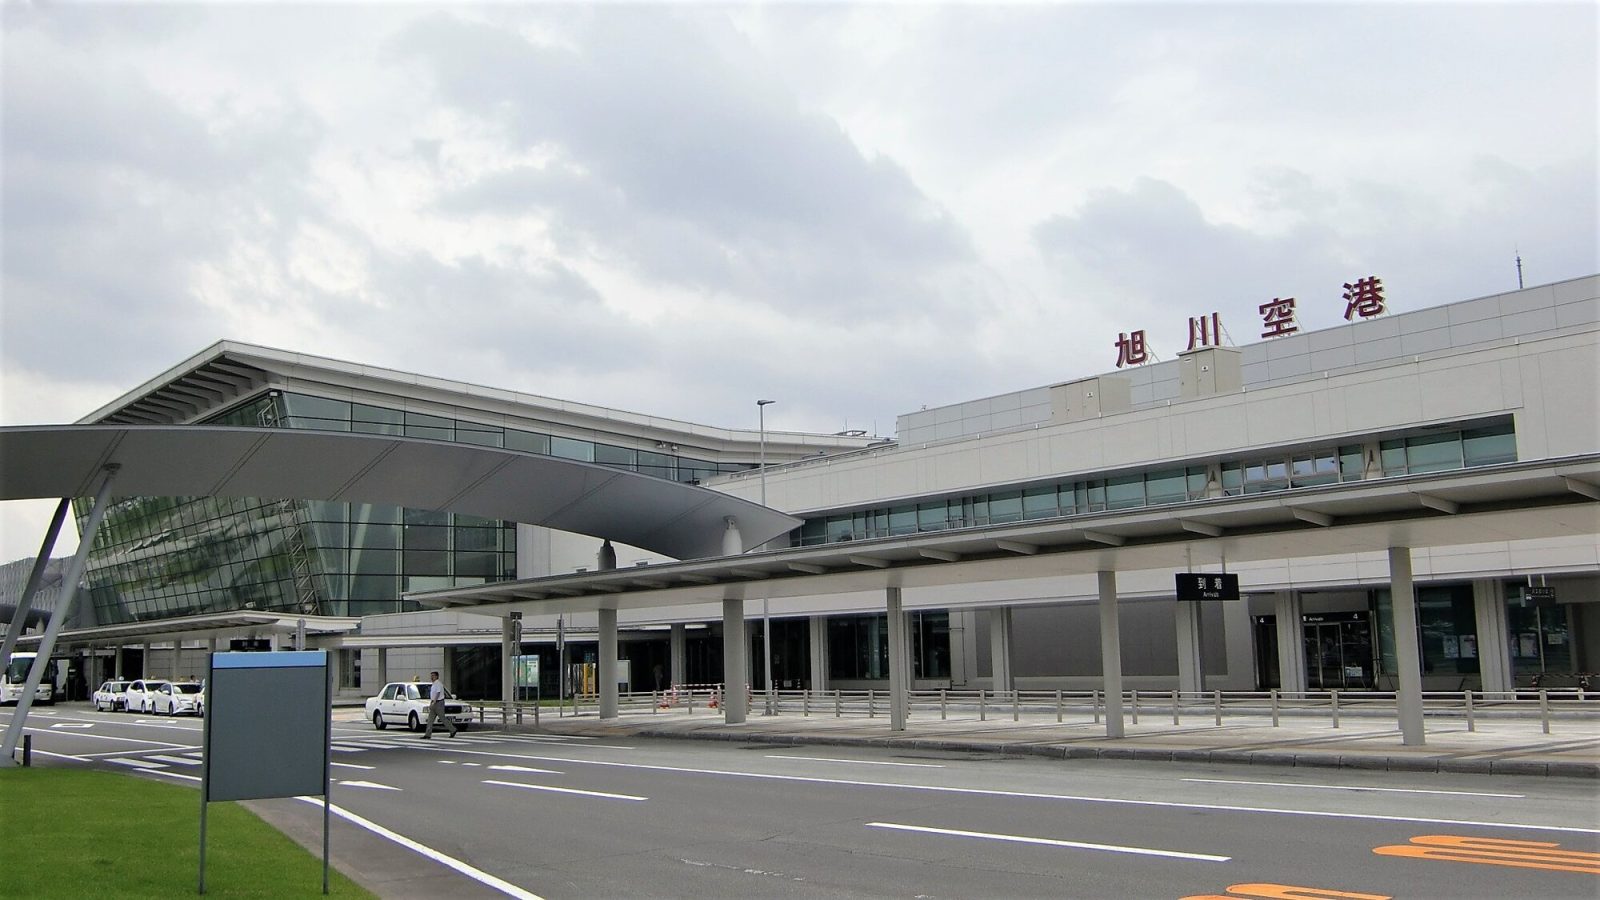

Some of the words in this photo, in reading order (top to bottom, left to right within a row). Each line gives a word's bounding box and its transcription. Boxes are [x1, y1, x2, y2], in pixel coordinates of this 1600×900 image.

[1115, 276, 1385, 367] 旭川空港
[1197, 577, 1222, 590] 到着
